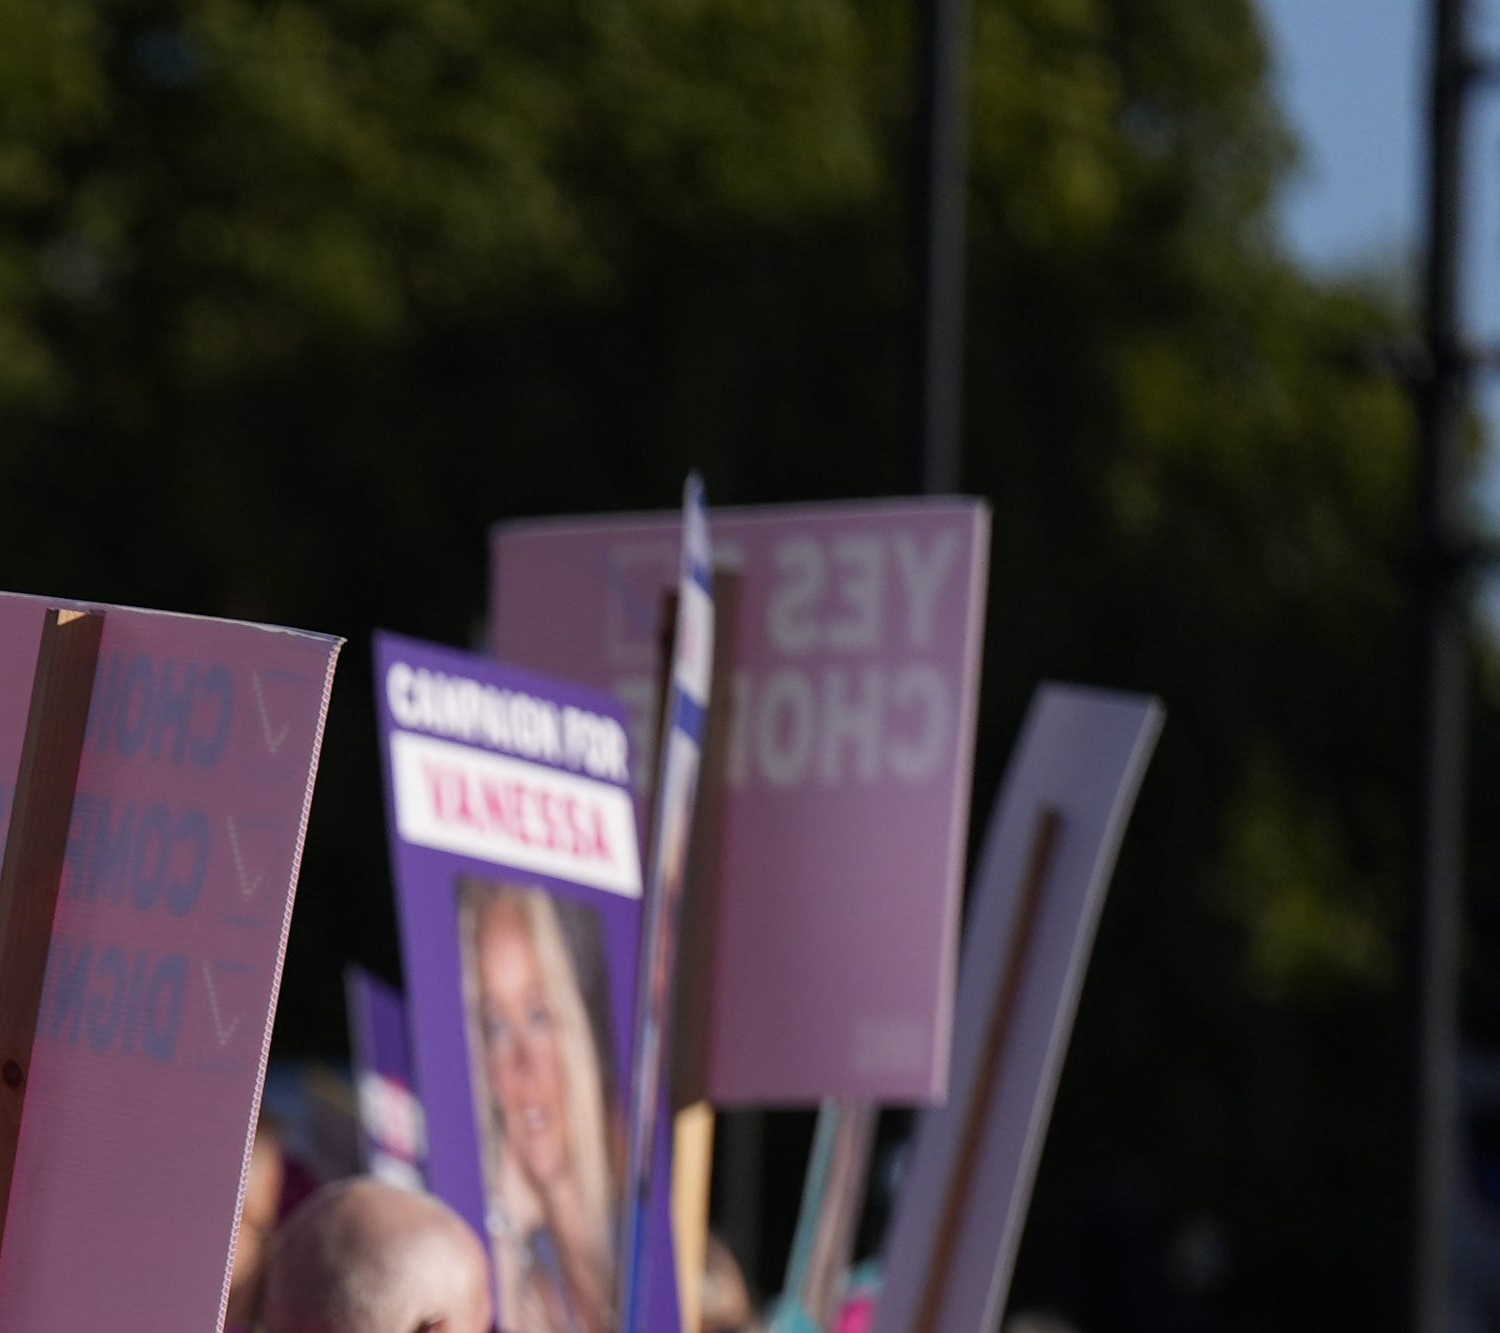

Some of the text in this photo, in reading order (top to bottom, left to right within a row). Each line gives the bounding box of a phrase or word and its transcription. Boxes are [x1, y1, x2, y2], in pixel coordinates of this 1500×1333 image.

[386, 661, 630, 783] CAMPAIGN FOR
[420, 755, 617, 868] VANESSA
